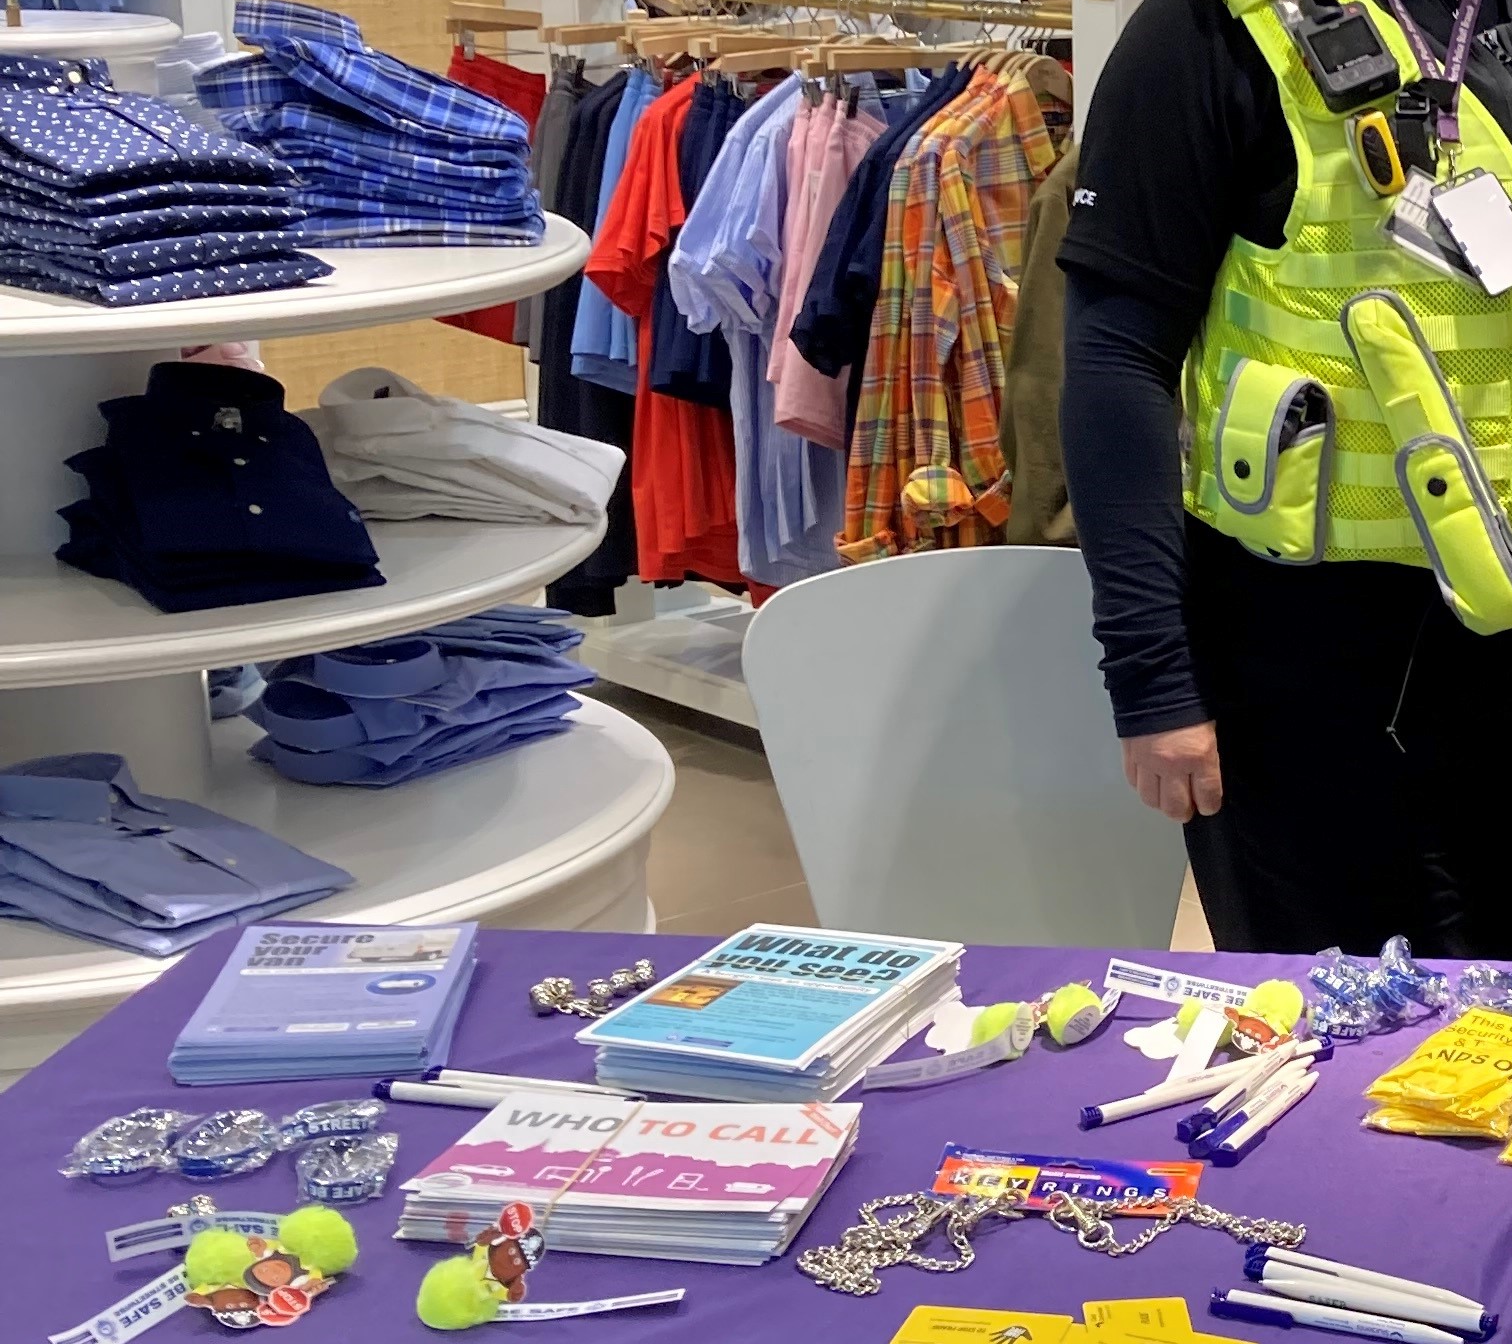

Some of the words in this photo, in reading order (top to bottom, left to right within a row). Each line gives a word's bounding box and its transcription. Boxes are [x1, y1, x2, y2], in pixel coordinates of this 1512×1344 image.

[253, 945, 328, 957] your
[259, 933, 375, 945] Secure
[736, 935, 858, 961] What
[857, 949, 921, 969] do
[247, 957, 306, 967] van
[706, 953, 790, 973] you
[790, 960, 901, 984] see?
[1471, 1015, 1505, 1031] This
[507, 1109, 624, 1133] WHO
[639, 1120, 696, 1138] TO
[708, 1123, 819, 1145] CALL
[953, 1172, 1026, 1190] KEY
[1041, 1181, 1168, 1199] RINGS
[508, 1206, 523, 1234] STOP
[118, 1297, 163, 1330] SAFE
